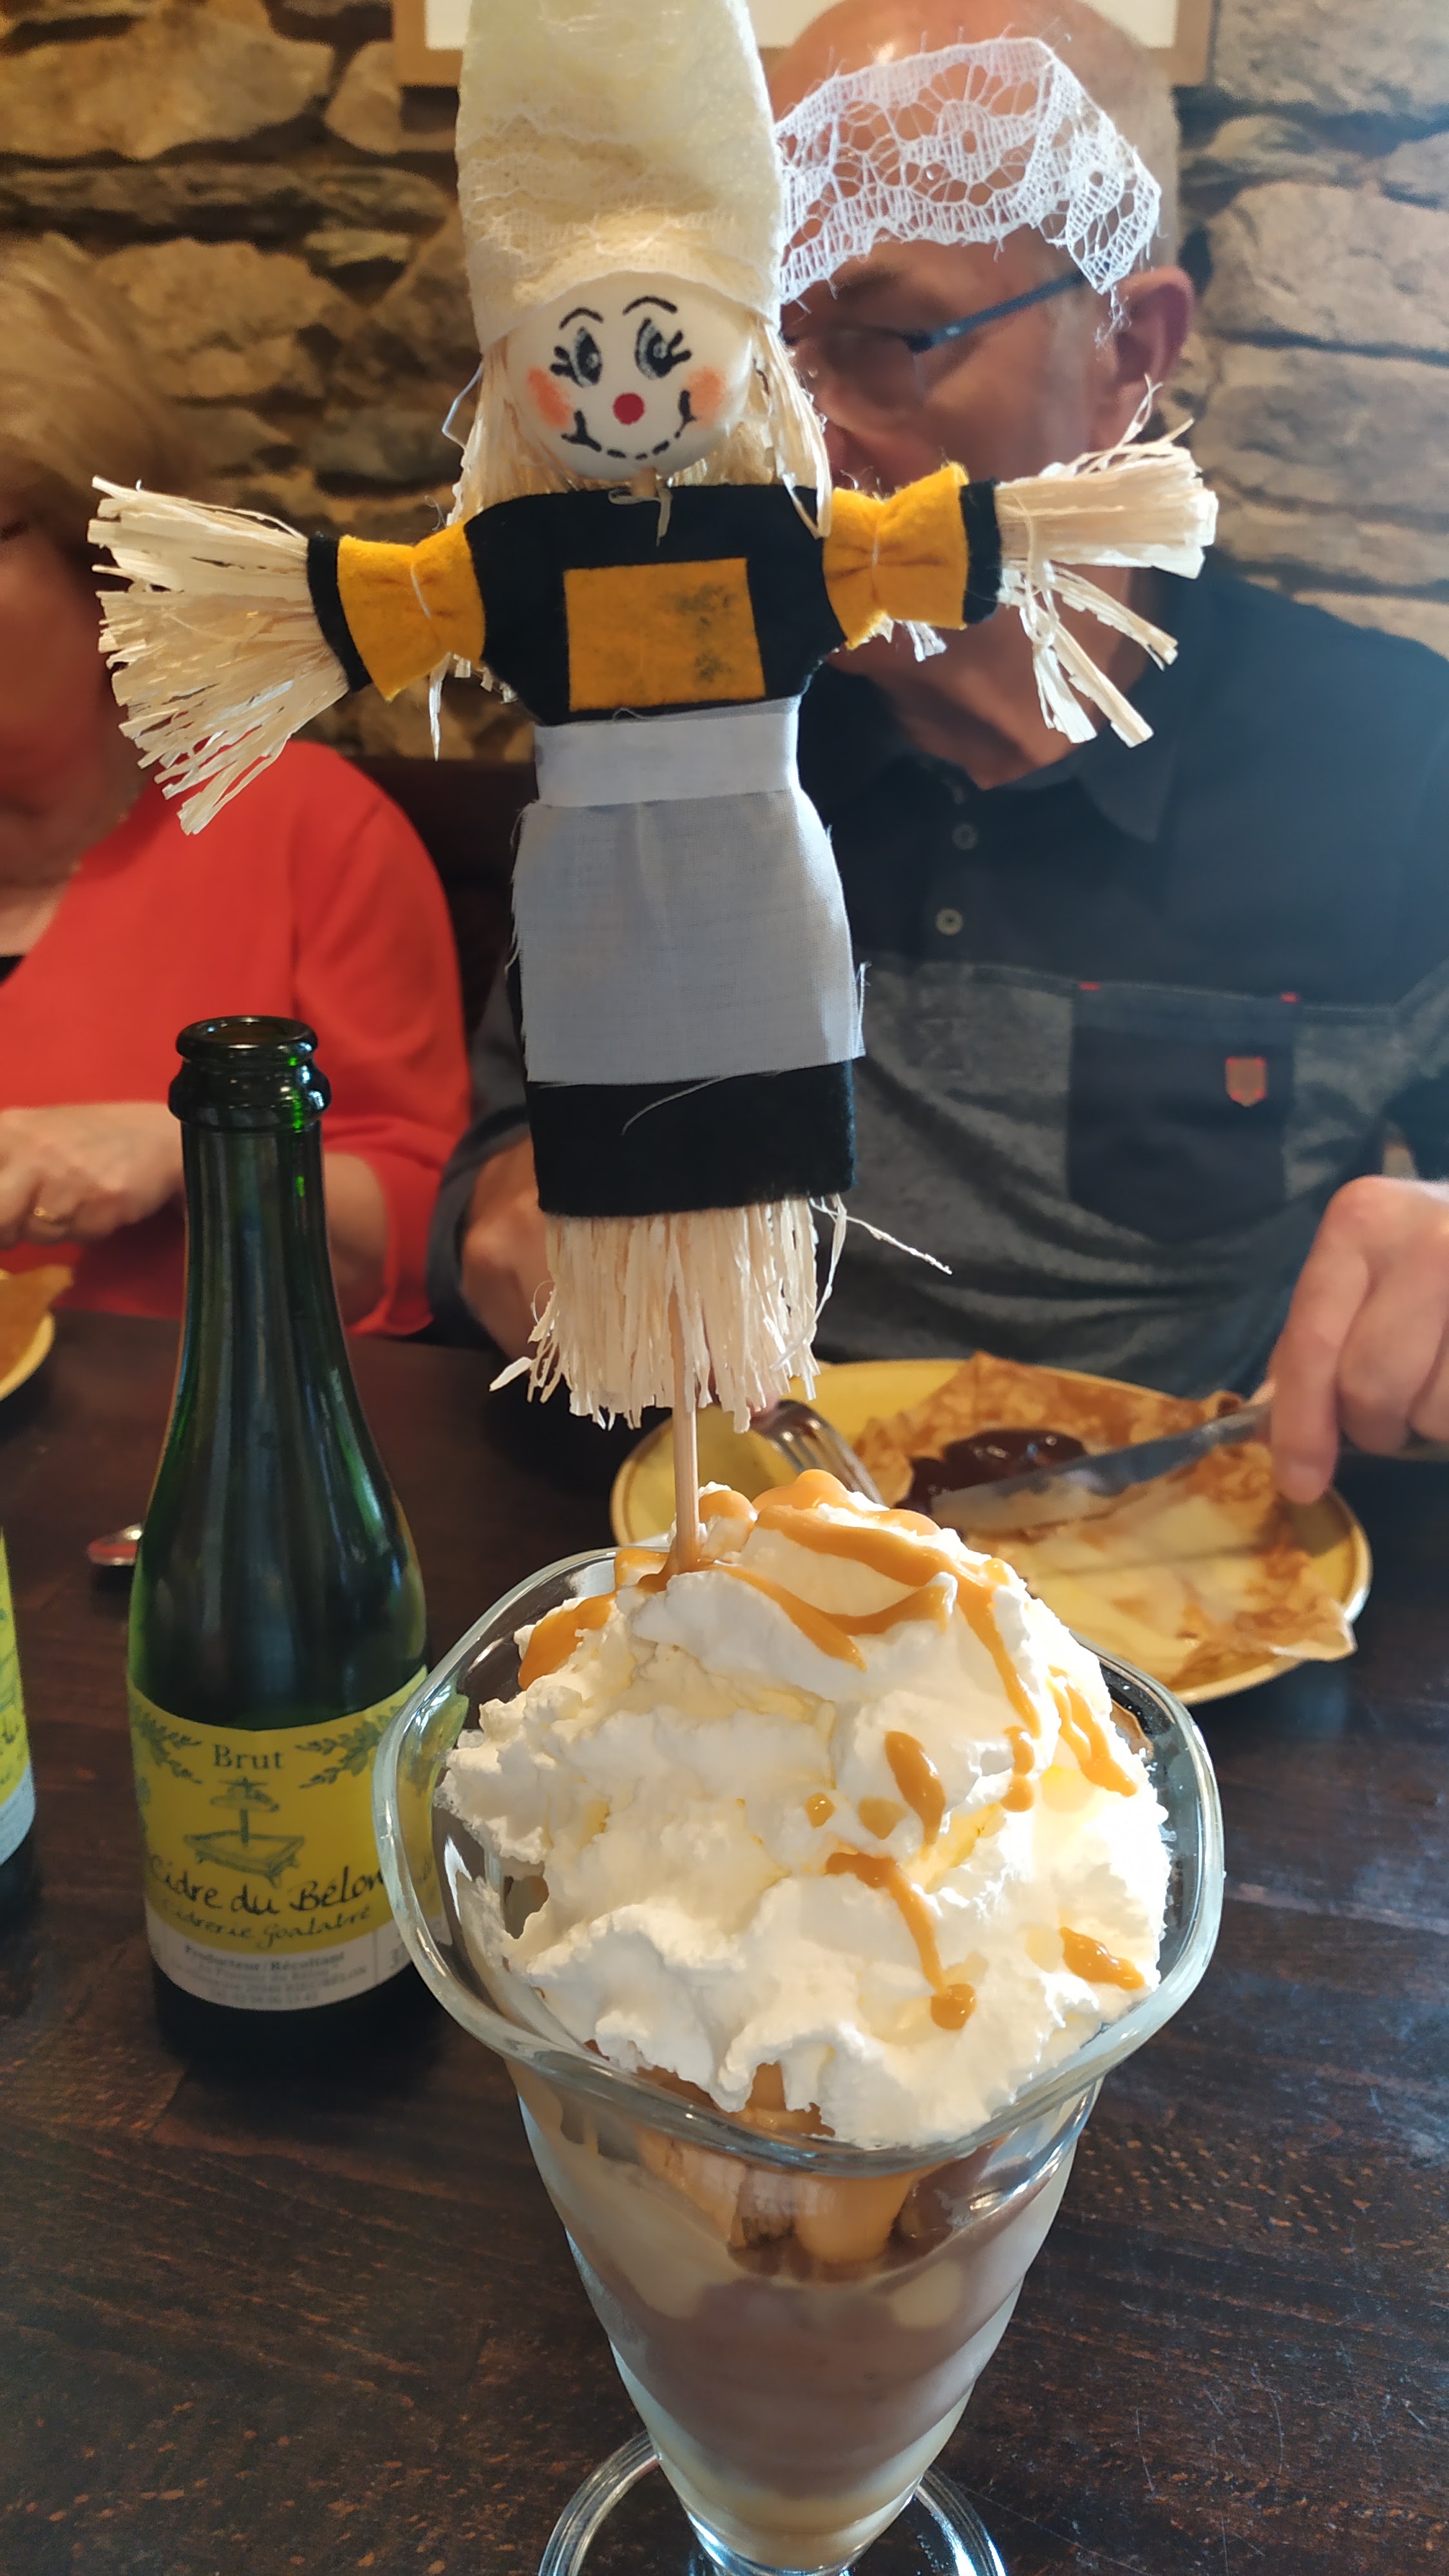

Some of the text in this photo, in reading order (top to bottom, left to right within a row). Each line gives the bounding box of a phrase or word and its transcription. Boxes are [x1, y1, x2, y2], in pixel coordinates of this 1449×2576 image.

[213, 1743, 284, 1770] Brut
[149, 1855, 223, 1909] Cidre
[231, 1883, 279, 1915] du
